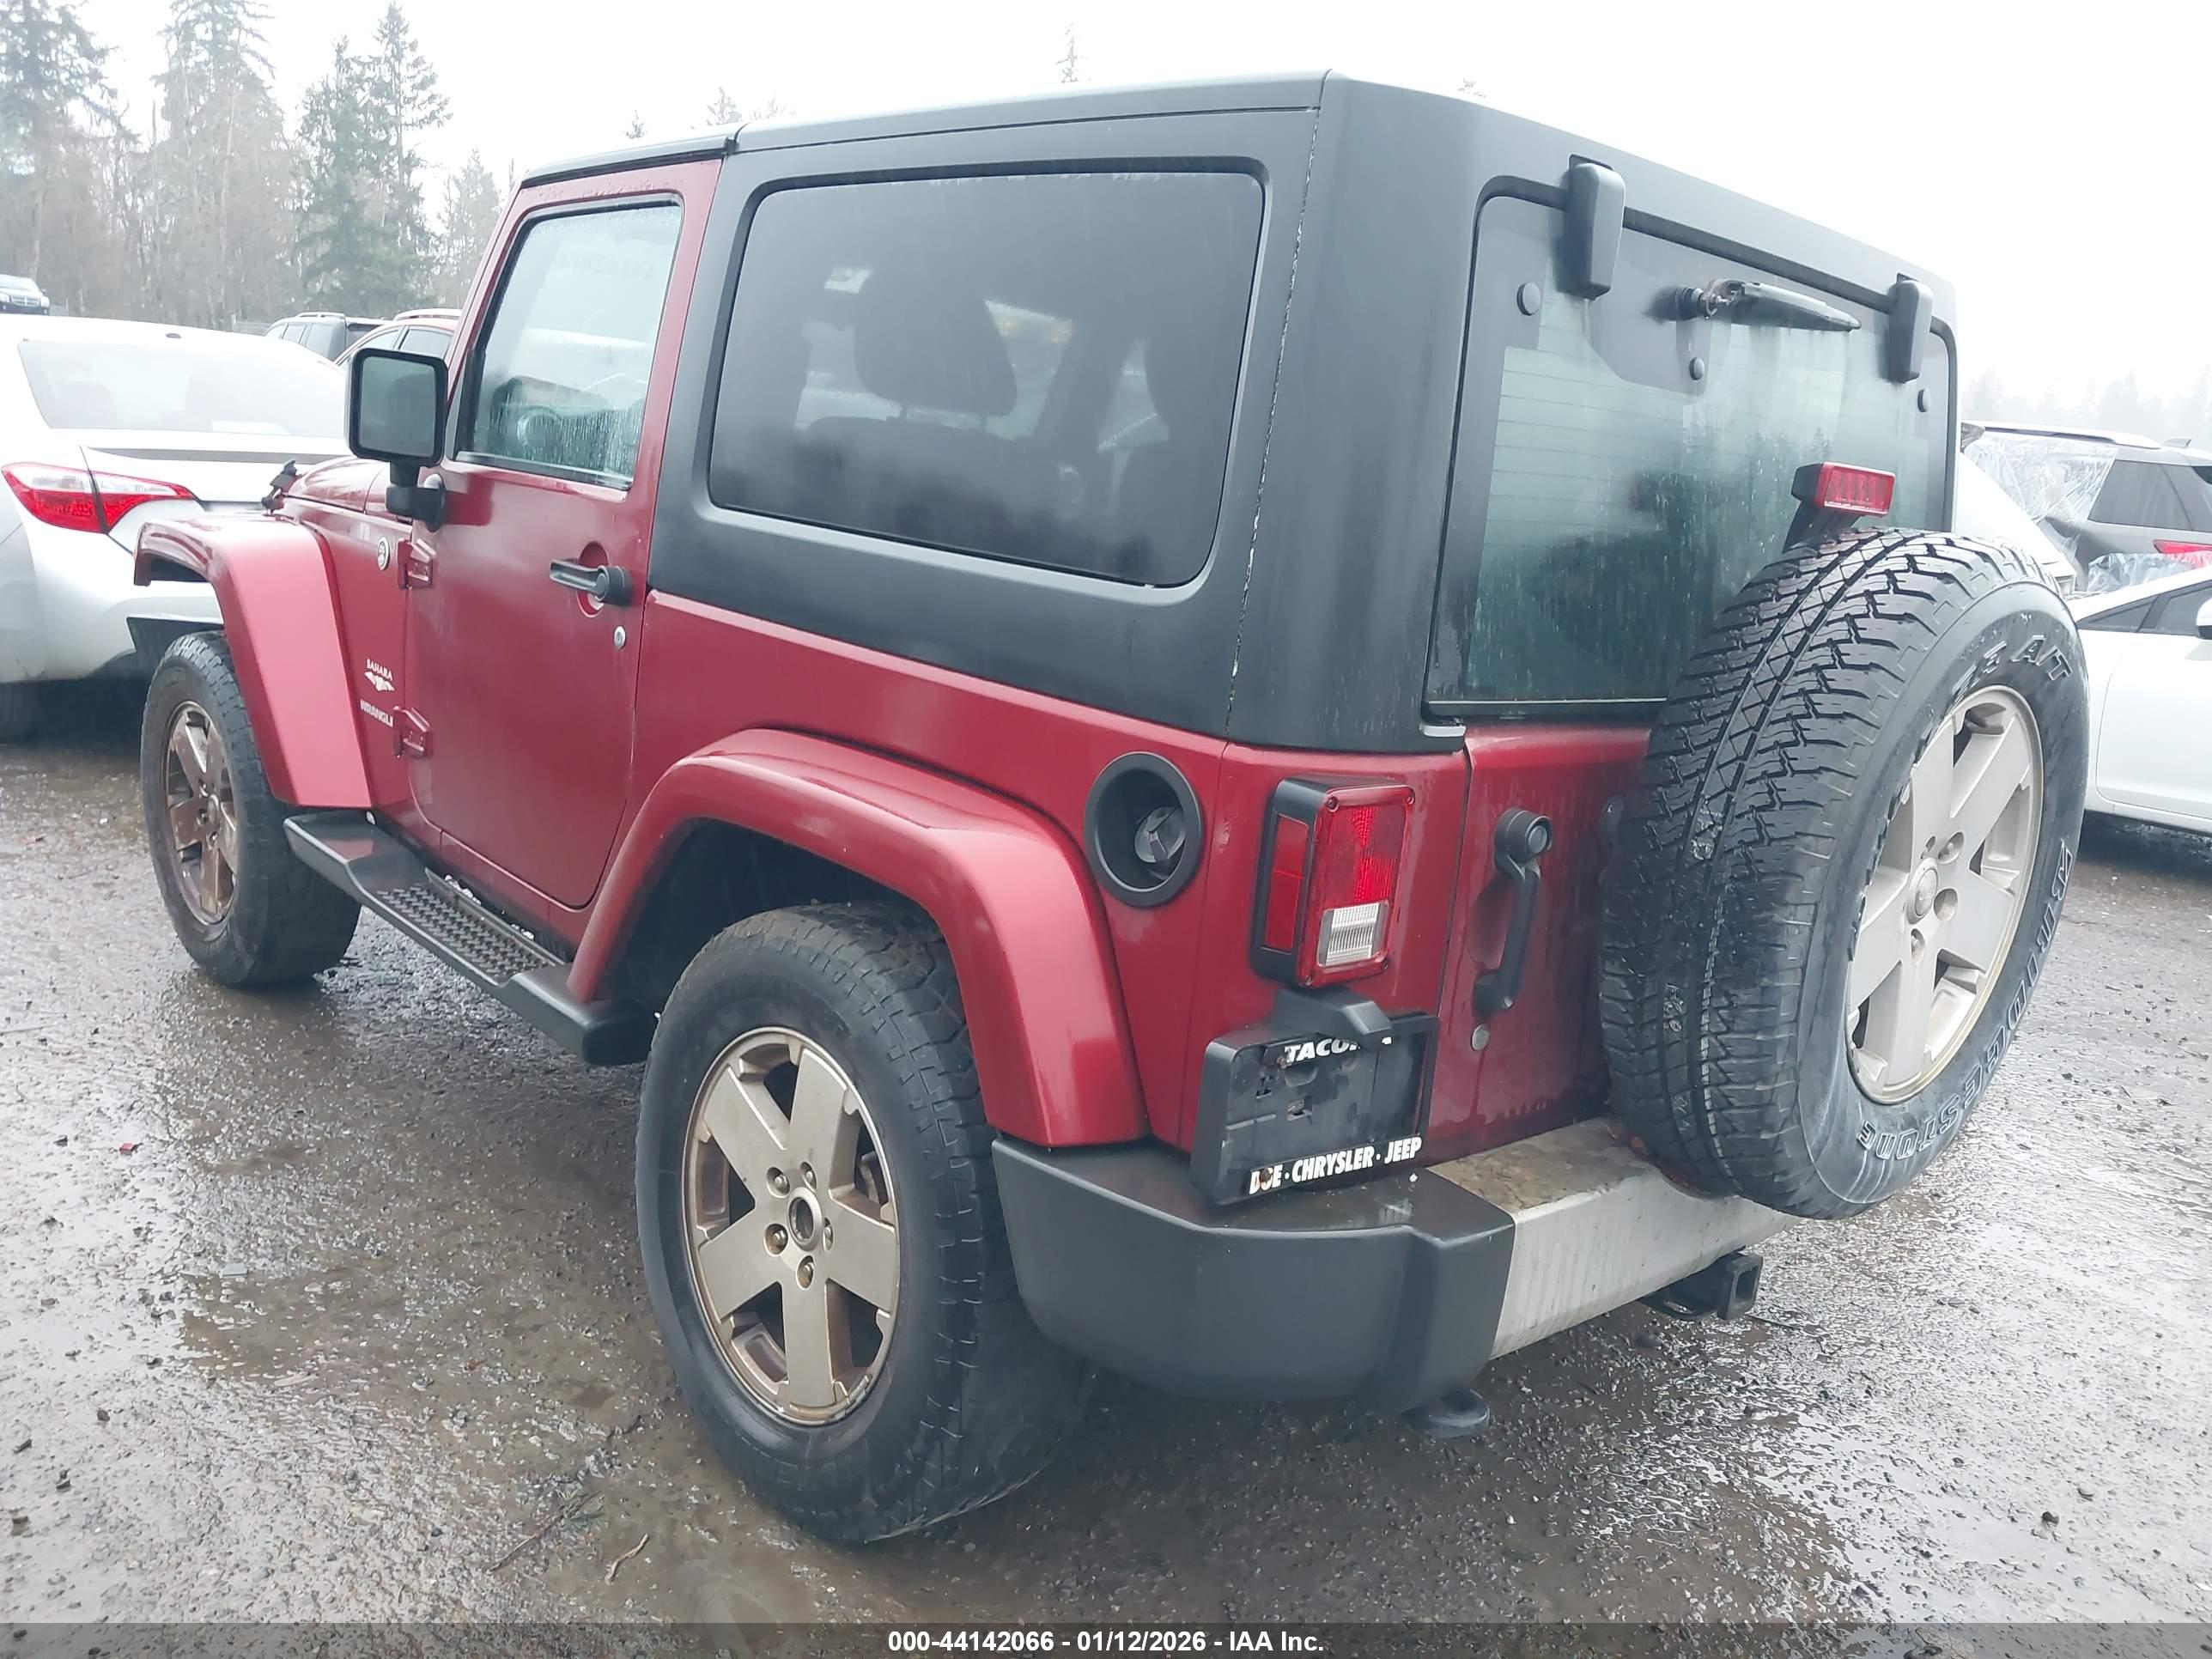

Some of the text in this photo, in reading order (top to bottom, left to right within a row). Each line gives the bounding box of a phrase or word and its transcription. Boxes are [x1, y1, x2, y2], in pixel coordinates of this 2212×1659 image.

[366, 658, 393, 681] SAHARA
[361, 698, 393, 728] WRANGL
[1856, 838, 2074, 1160] BRIDGESTONE
[1291, 1146, 1376, 1183] CHRYSLER
[1384, 1137, 1422, 1164] JEEP
